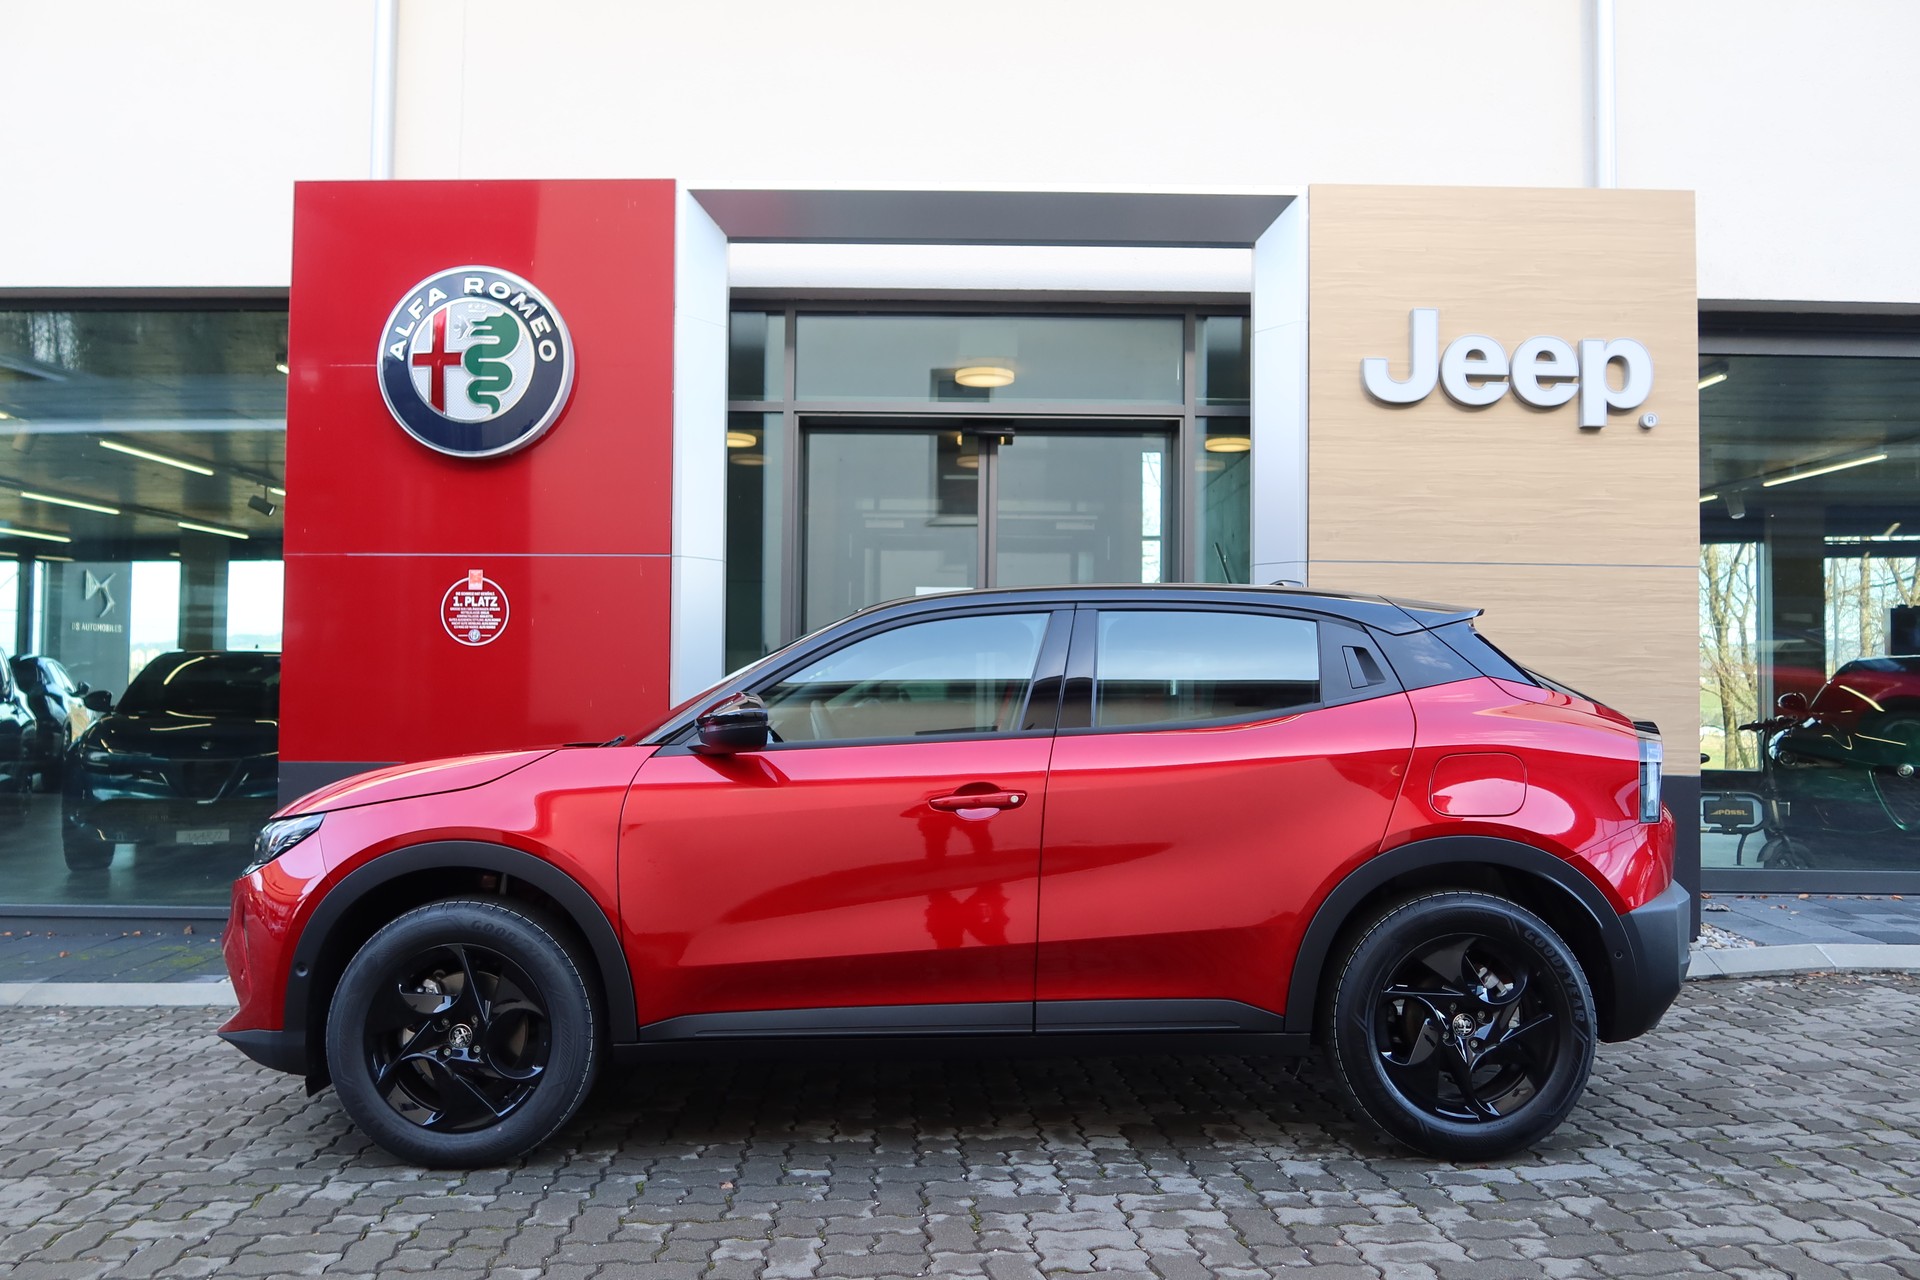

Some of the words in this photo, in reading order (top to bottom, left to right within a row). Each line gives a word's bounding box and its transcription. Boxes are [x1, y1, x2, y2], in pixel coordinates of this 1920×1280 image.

[389, 287, 448, 362] ALFA
[463, 277, 557, 362] ROMEO
[1361, 307, 1654, 430] Jeep
[453, 596, 463, 607] 1.
[464, 596, 498, 607] PLATZ
[71, 622, 80, 631] DS
[81, 622, 122, 633] AUTOMOBILES
